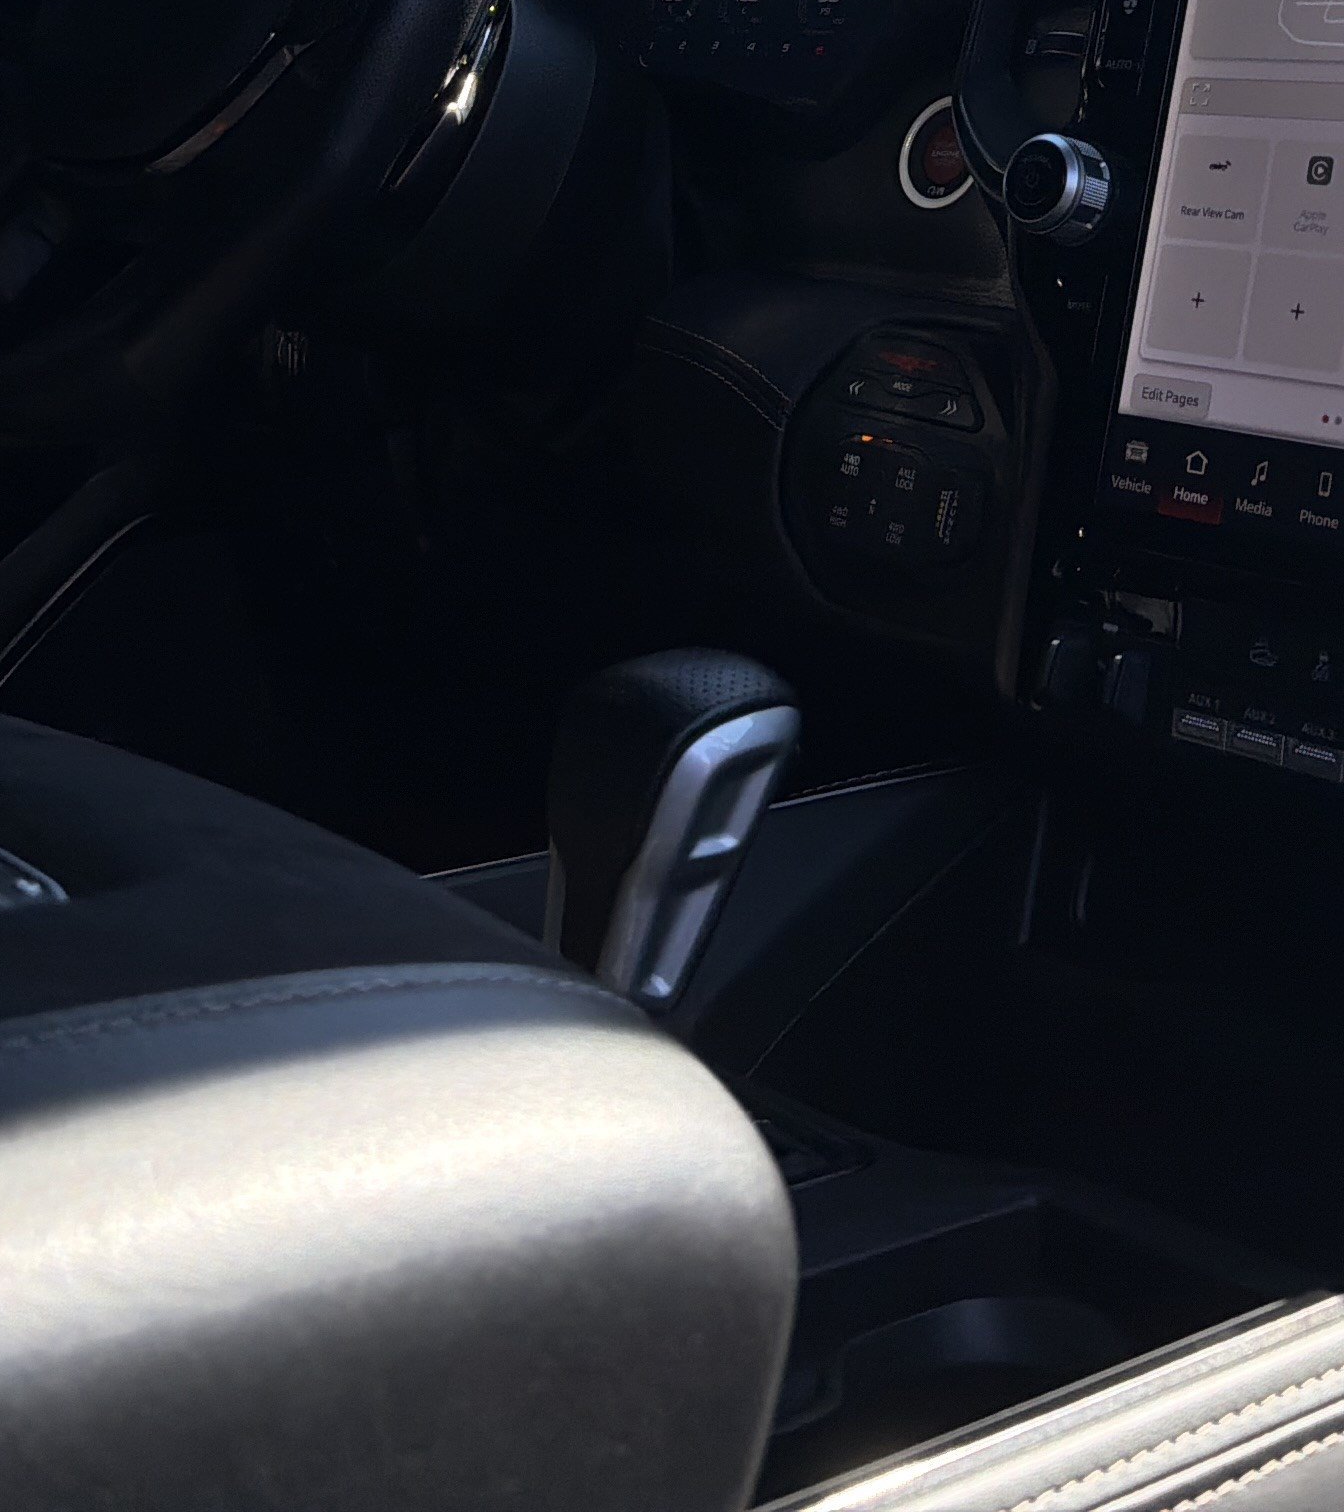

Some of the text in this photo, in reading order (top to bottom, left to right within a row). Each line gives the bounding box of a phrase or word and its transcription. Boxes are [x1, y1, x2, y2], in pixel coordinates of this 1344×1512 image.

[1180, 206, 1245, 220] Rear View Cam
[1141, 387, 1200, 408] Edit Pages
[1111, 474, 1152, 495] Vehicle
[1173, 485, 1209, 506] Home
[1235, 497, 1273, 517] Media
[1299, 509, 1339, 530] Phone
